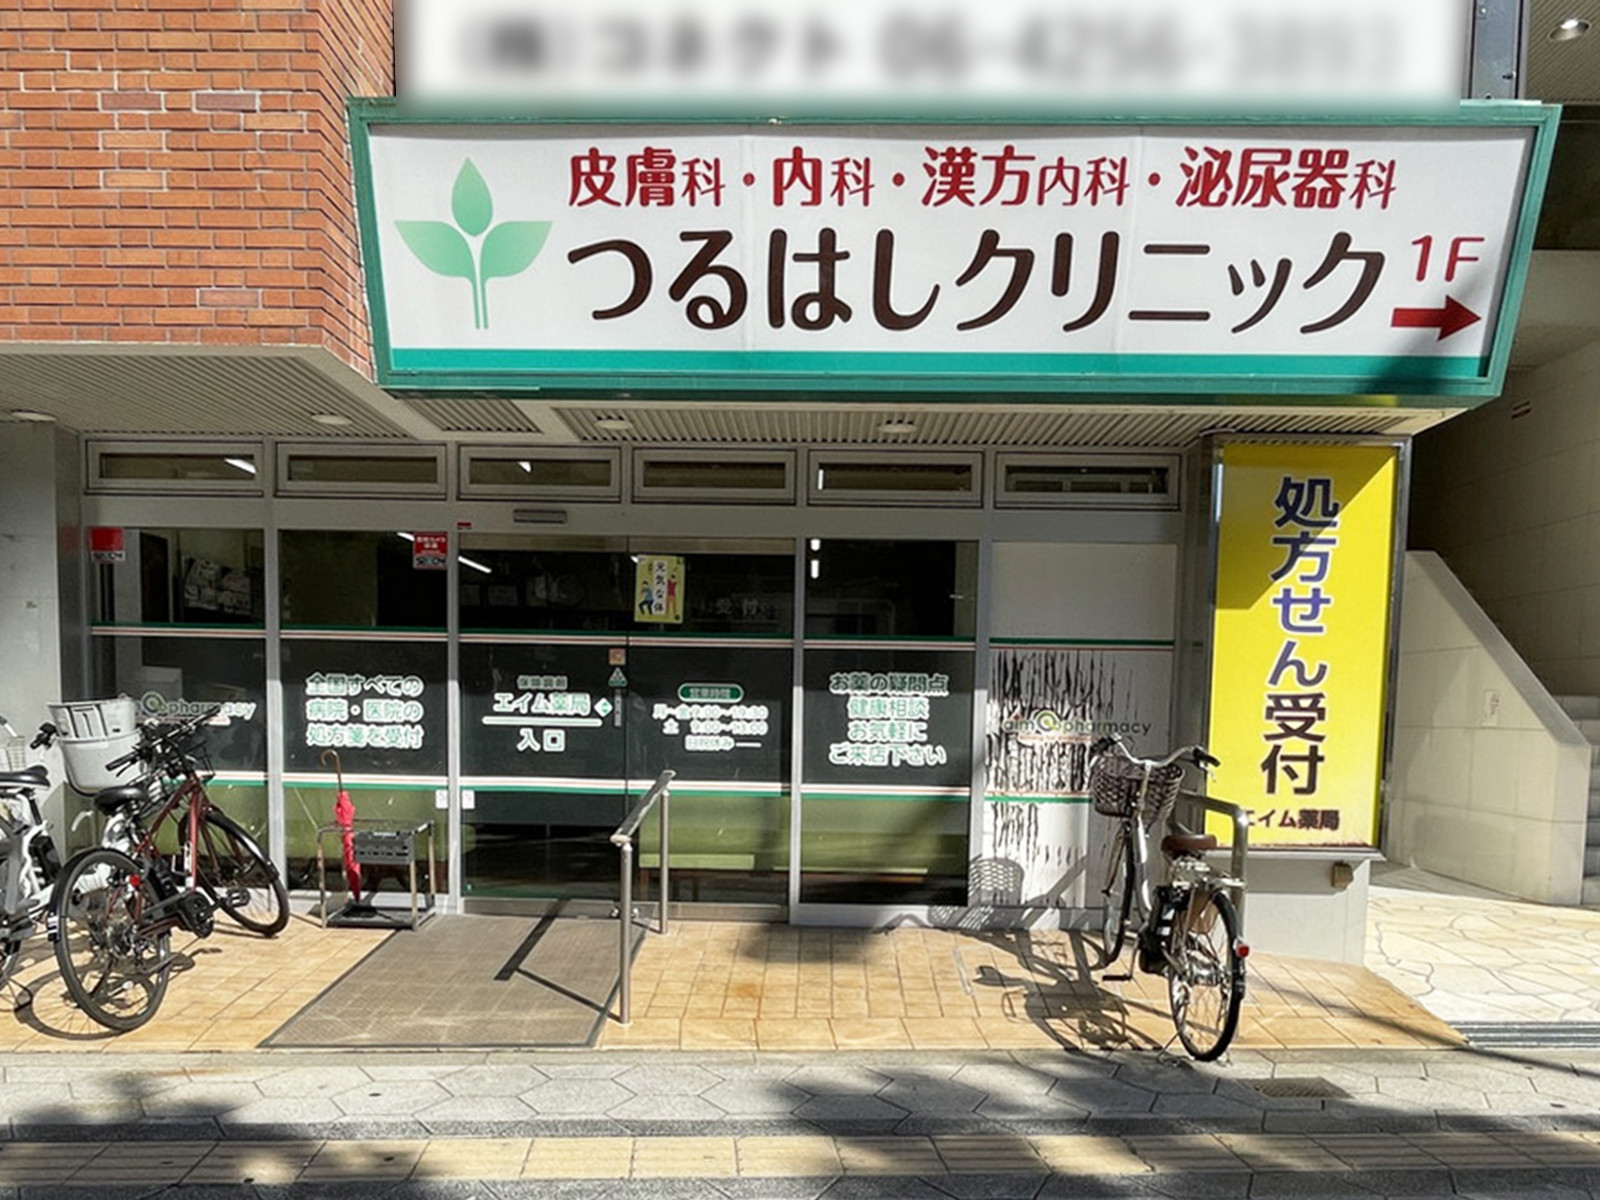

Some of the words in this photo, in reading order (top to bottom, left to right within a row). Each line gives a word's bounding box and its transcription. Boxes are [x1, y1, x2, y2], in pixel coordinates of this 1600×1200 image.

[569, 146, 1396, 210] 皮膚科・内科・漢方内科・泌尿器科
[1411, 236, 1485, 282] 1F
[567, 227, 1386, 334] つるはしクリニック
[1260, 476, 1340, 796] 処方せん受付
[305, 671, 424, 697] 全国すべての
[829, 671, 949, 696] お薬の疑問点
[305, 697, 424, 722] 病院・医院の
[493, 692, 591, 716] エイム薬局
[846, 696, 930, 720] 健康相談
[847, 719, 928, 742] お気軽に
[1062, 714, 1152, 736] pharmacy
[517, 727, 566, 752] 入口
[828, 741, 948, 767] ご来店下さい
